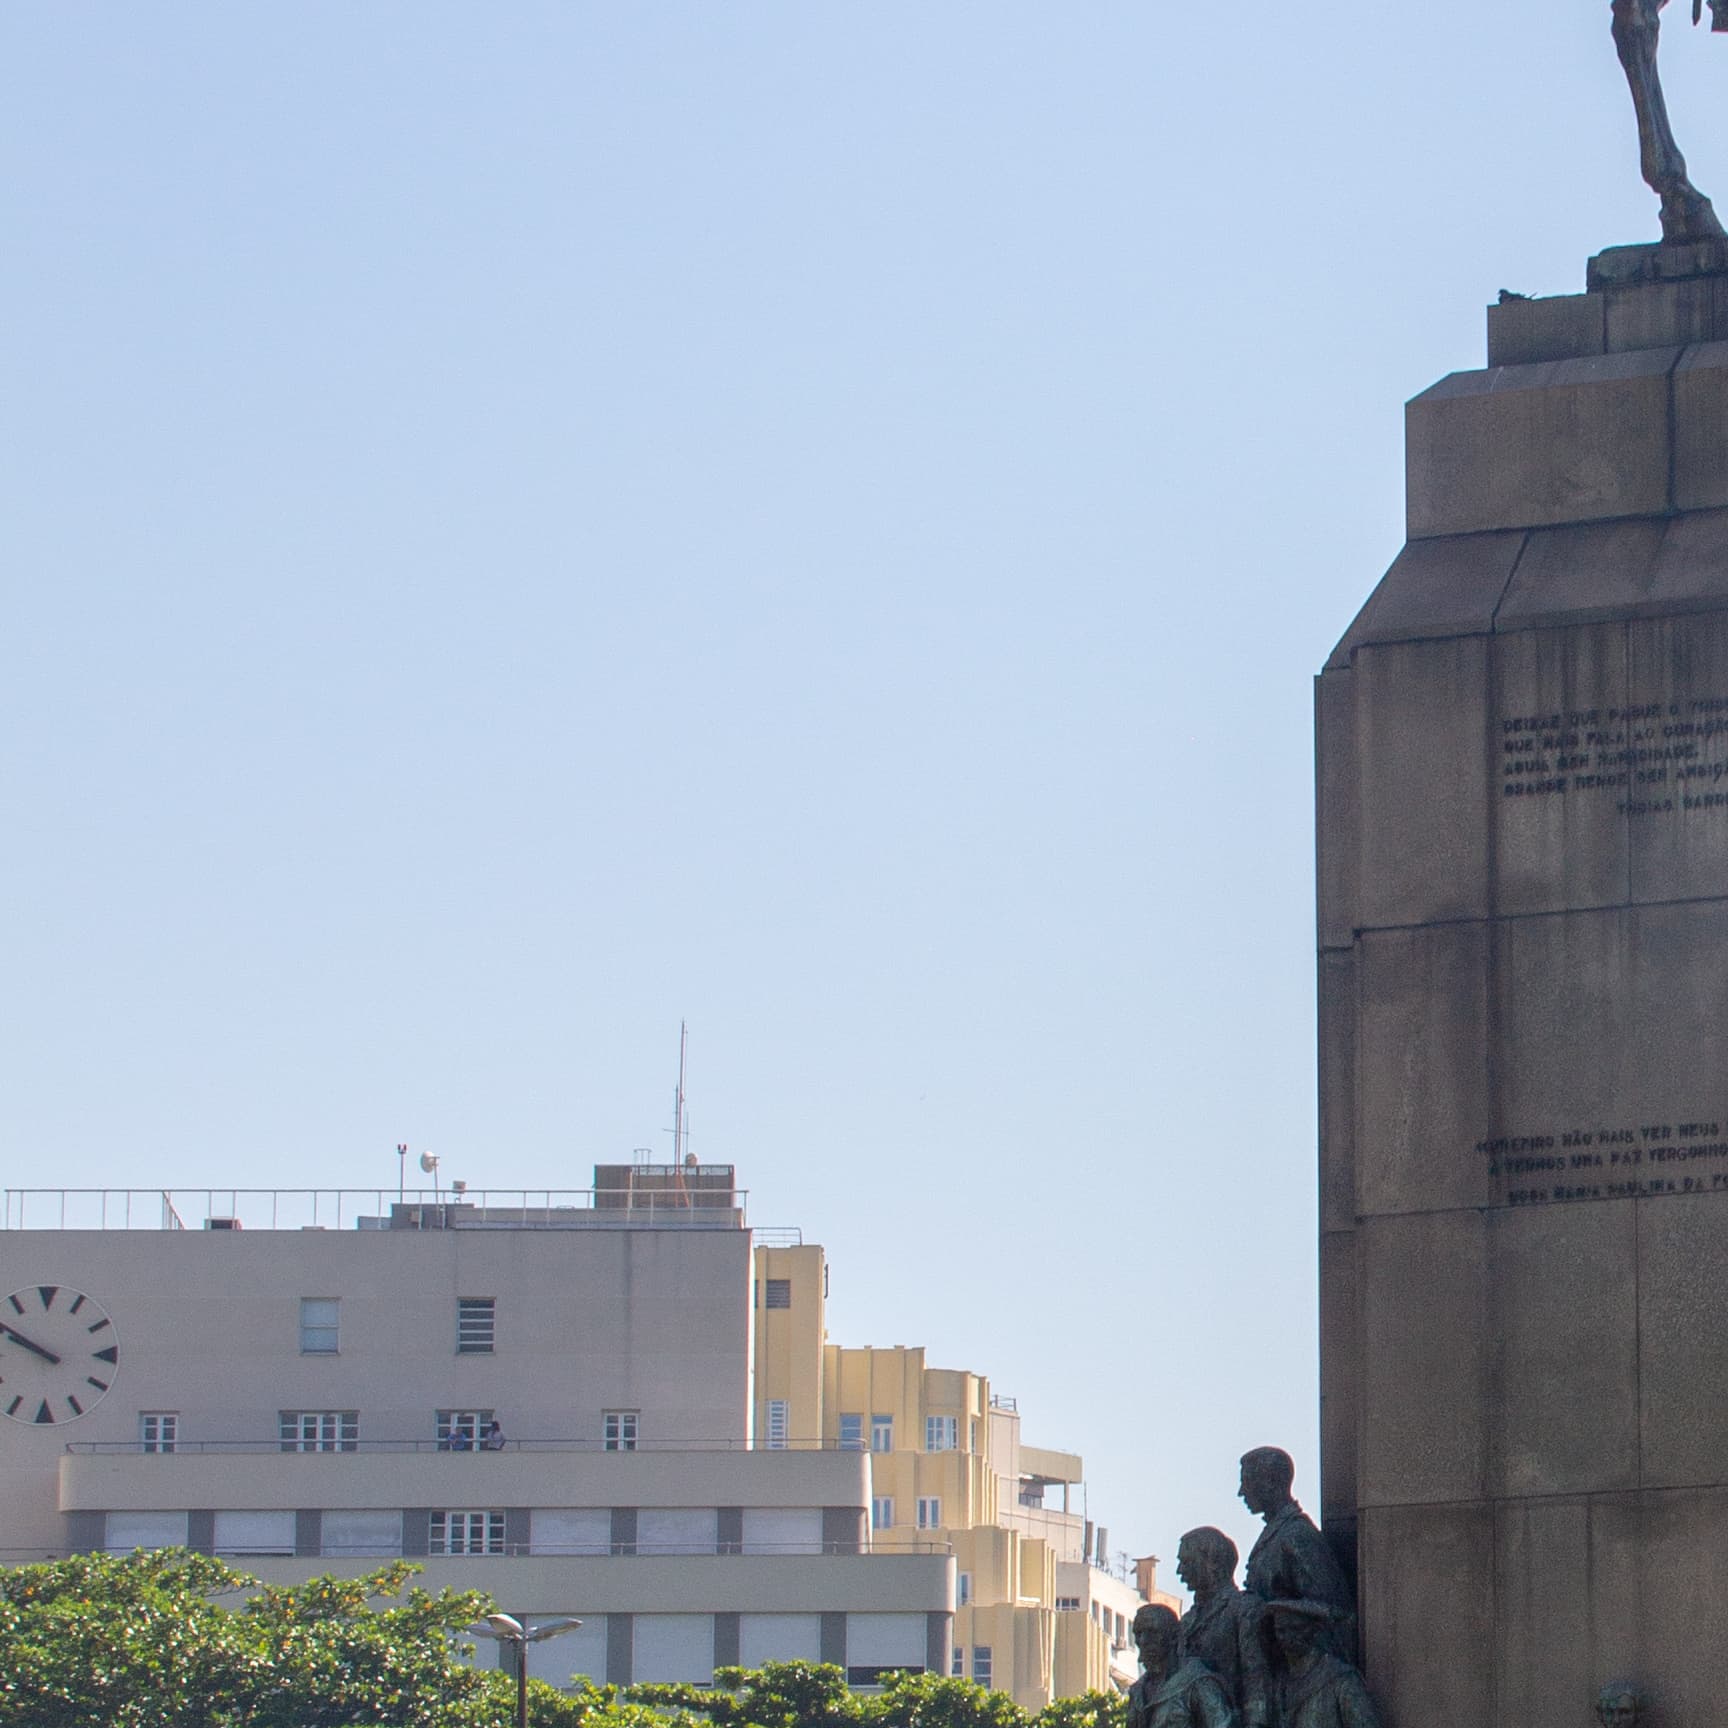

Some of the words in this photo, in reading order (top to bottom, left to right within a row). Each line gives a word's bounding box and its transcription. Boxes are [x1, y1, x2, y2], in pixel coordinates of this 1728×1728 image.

[1669, 703, 1678, 715] O
[1504, 738, 1533, 753] QUE
[1562, 1129, 1593, 1147] NÃO
[1641, 1123, 1671, 1141] VER
[1679, 1122, 1719, 1138] MEUS
[1571, 1153, 1603, 1169] UMA
[1610, 1149, 1642, 1166] PAZ
[1553, 1184, 1600, 1200] MARIA
[1683, 1176, 1704, 1191] DA
